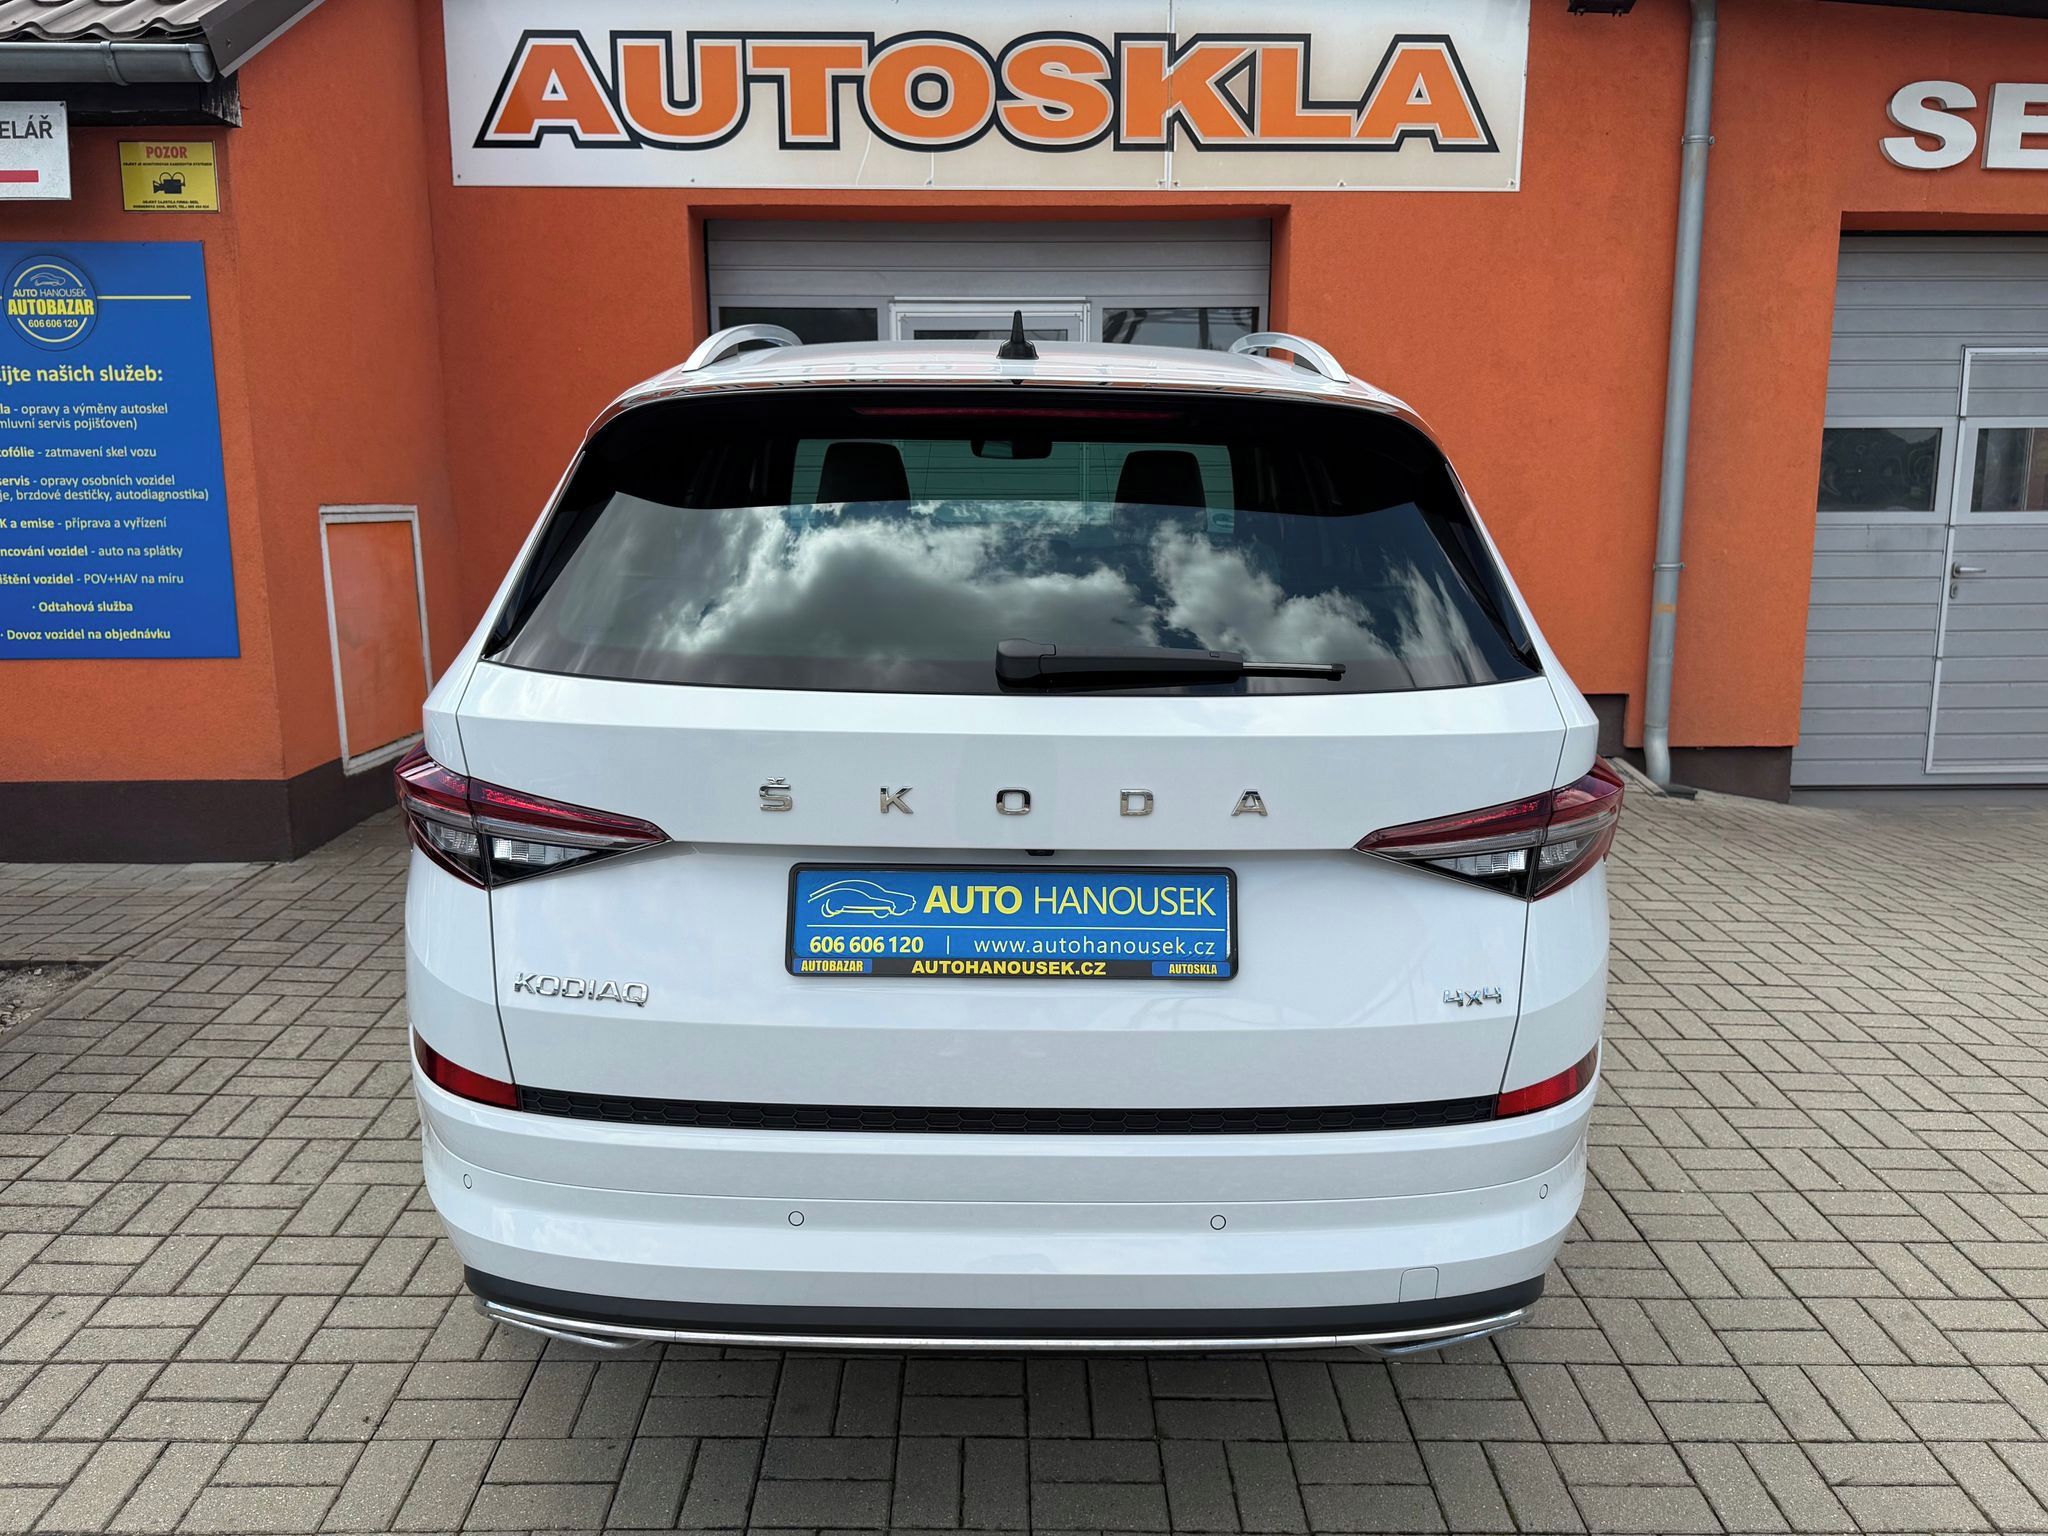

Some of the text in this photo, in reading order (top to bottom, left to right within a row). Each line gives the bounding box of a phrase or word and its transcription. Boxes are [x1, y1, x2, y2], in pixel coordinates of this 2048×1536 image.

[473, 29, 1500, 153] AUTOSKLA
[1879, 80, 2048, 171] SE
[145, 146, 188, 159] POZOR
[13, 289, 87, 297] AUTO HANOUSEK
[8, 299, 95, 315] AUTOBAZAR
[28, 319, 79, 328] 606 606 120
[0, 365, 163, 386] ijte našich služeb:
[21, 404, 60, 417] opravy
[63, 405, 70, 414] a
[72, 403, 117, 417] výměny
[120, 403, 168, 414] autoskel
[38, 417, 71, 429] servis
[74, 417, 138, 431] pojišťoven)
[45, 446, 103, 458] zatmavení
[106, 446, 128, 458] skel
[130, 448, 157, 458] vozu
[40, 476, 79, 489] opravy
[81, 475, 133, 486] osobních
[135, 475, 175, 486] vozidel
[16, 489, 61, 501] brzdové
[64, 489, 112, 502] destičky,
[115, 488, 209, 501] autodiagnostika)
[10, 519, 17, 529] a
[20, 518, 55, 529] emise
[65, 517, 111, 531] příprava
[114, 519, 121, 529] a
[123, 517, 167, 531] vyřízení
[48, 545, 88, 557] vozidel
[98, 546, 124, 557] auto
[127, 547, 141, 557] na
[144, 545, 183, 559] splátky
[33, 573, 74, 585] vozidel
[84, 573, 138, 585] POV+HAV
[141, 575, 155, 584] na
[158, 573, 184, 584] míru
[38, 601, 133, 613] Odtahová služba
[6, 629, 171, 642] Dovoz vozidel na objednávku
[923, 885, 1217, 917] AUTO HANOUSEK
[809, 935, 1215, 956] 606 606 120 www.autohanousek.cz
[801, 959, 1218, 976] AUTOBAZAR AUTOHANOUSEK.CZ AUTOSKLA
[514, 972, 649, 1007] KODIAQ
